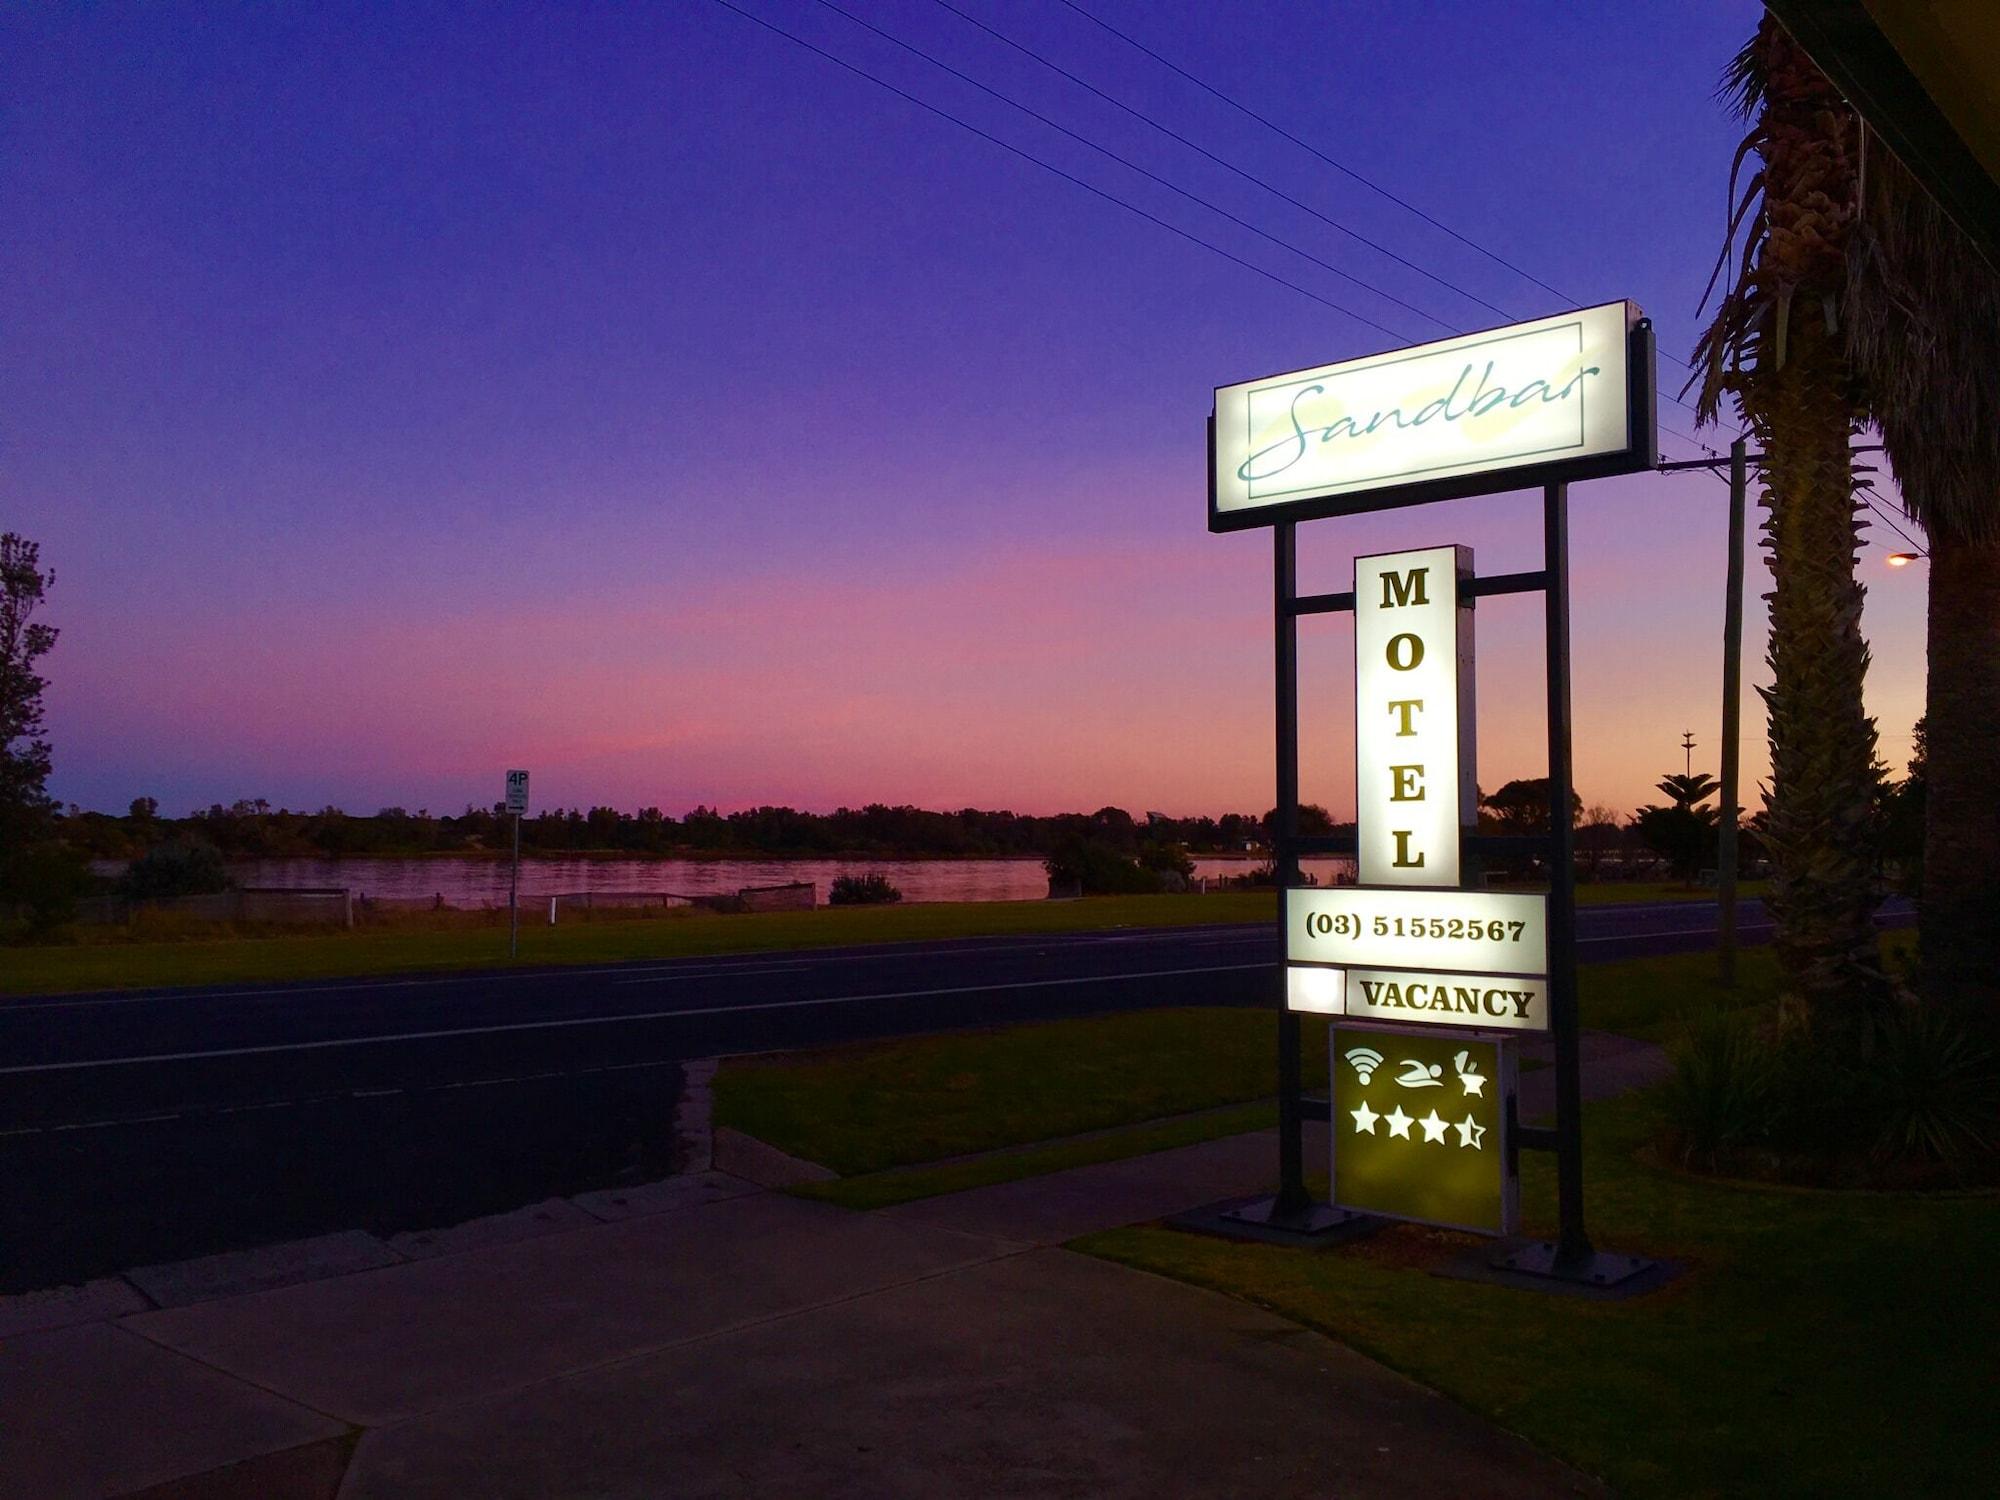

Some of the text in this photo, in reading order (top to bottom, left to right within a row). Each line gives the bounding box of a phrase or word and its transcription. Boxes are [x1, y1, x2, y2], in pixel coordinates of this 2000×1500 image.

[1237, 360, 1600, 482] Sandbar
[1379, 567, 1430, 868] MOTEL
[508, 772, 529, 786] 4P
[1306, 911, 1526, 942] (03) 51552567
[1359, 980, 1536, 1019] VACANCY
